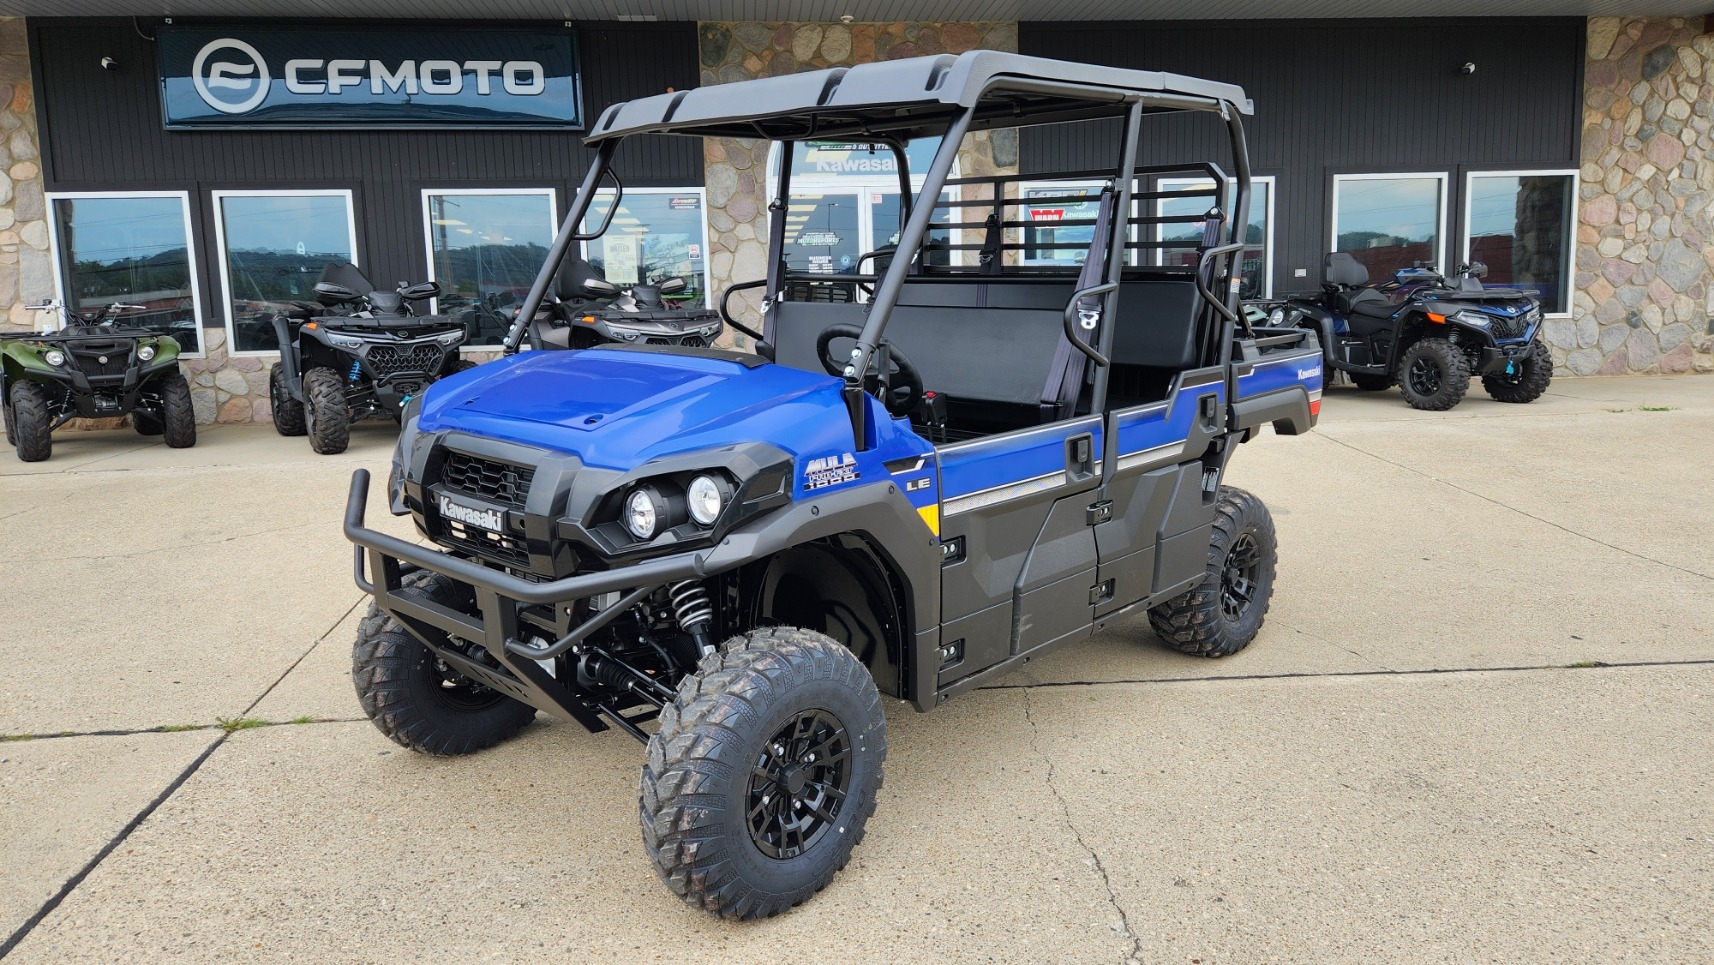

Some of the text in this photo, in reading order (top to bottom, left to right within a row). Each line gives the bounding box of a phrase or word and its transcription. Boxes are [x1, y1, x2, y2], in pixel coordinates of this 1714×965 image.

[285, 59, 545, 95] CFMOTO
[1298, 365, 1320, 380] Kawasaki
[906, 478, 931, 492] LE
[440, 495, 502, 532] Kawasaki
